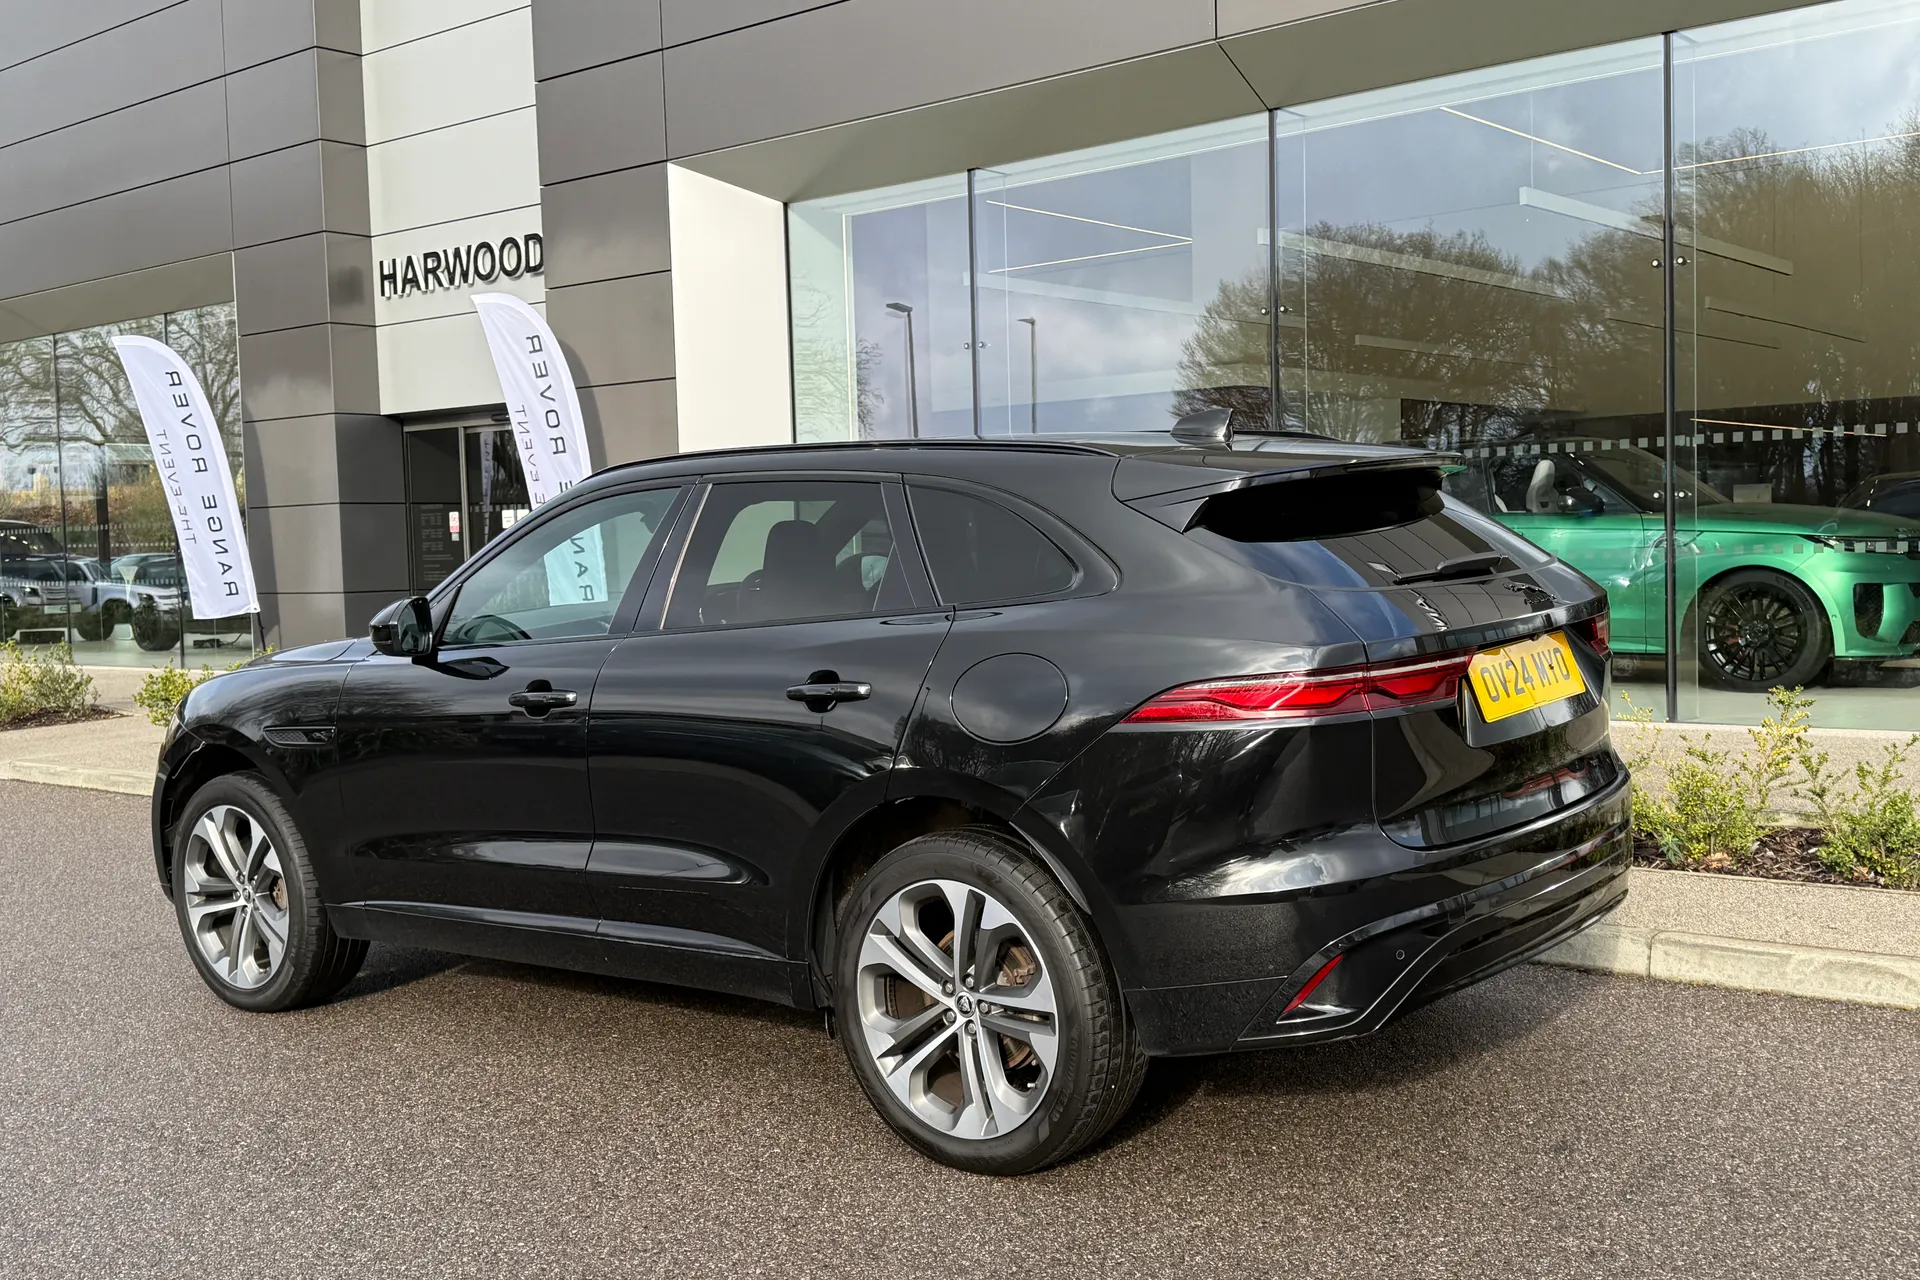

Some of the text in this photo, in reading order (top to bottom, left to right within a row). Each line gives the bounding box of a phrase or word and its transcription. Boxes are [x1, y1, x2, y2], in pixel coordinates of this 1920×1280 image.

[379, 232, 544, 298] HARWOOD
[1480, 647, 1571, 703] OV24 MYO
